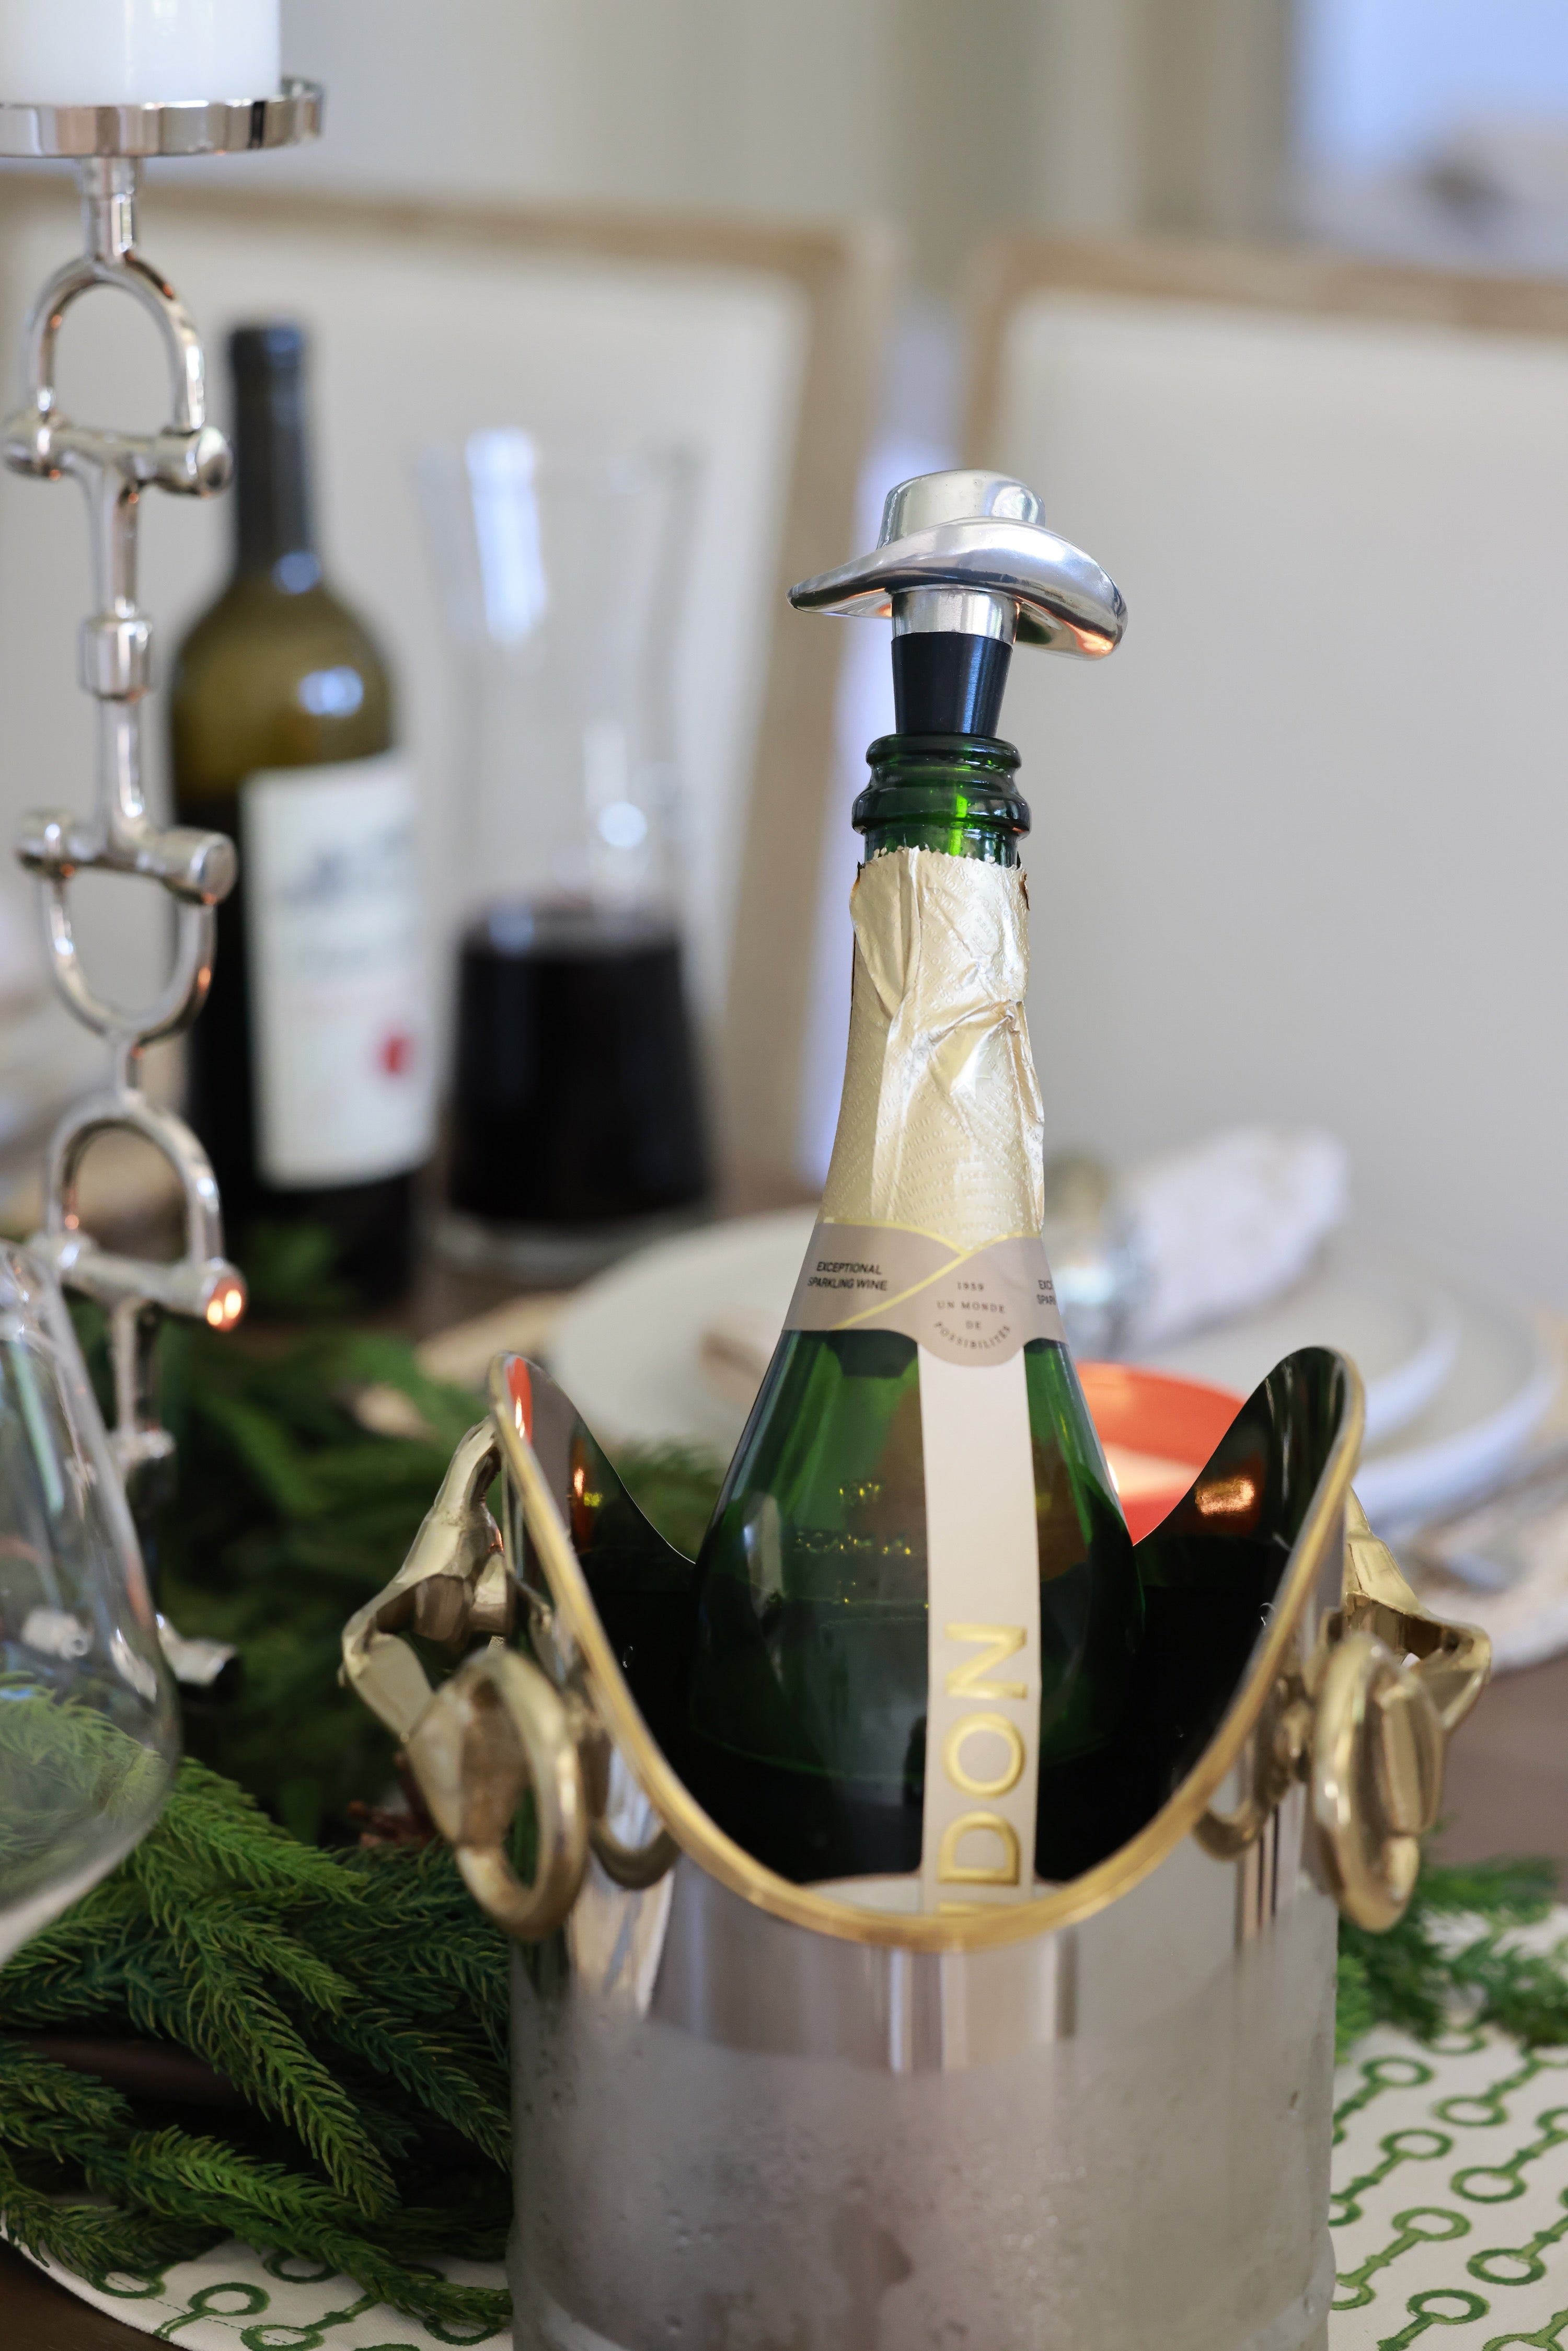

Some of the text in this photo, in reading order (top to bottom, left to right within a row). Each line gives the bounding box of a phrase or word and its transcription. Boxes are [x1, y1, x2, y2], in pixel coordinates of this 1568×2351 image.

[816, 1261, 882, 1275] EXCEPTIONAL
[808, 1276, 887, 1291] SPARKLING WINE
[937, 1301, 1005, 1313] UN MONDE
[965, 1320, 981, 1330] DE
[938, 1623, 1028, 1918] DON
